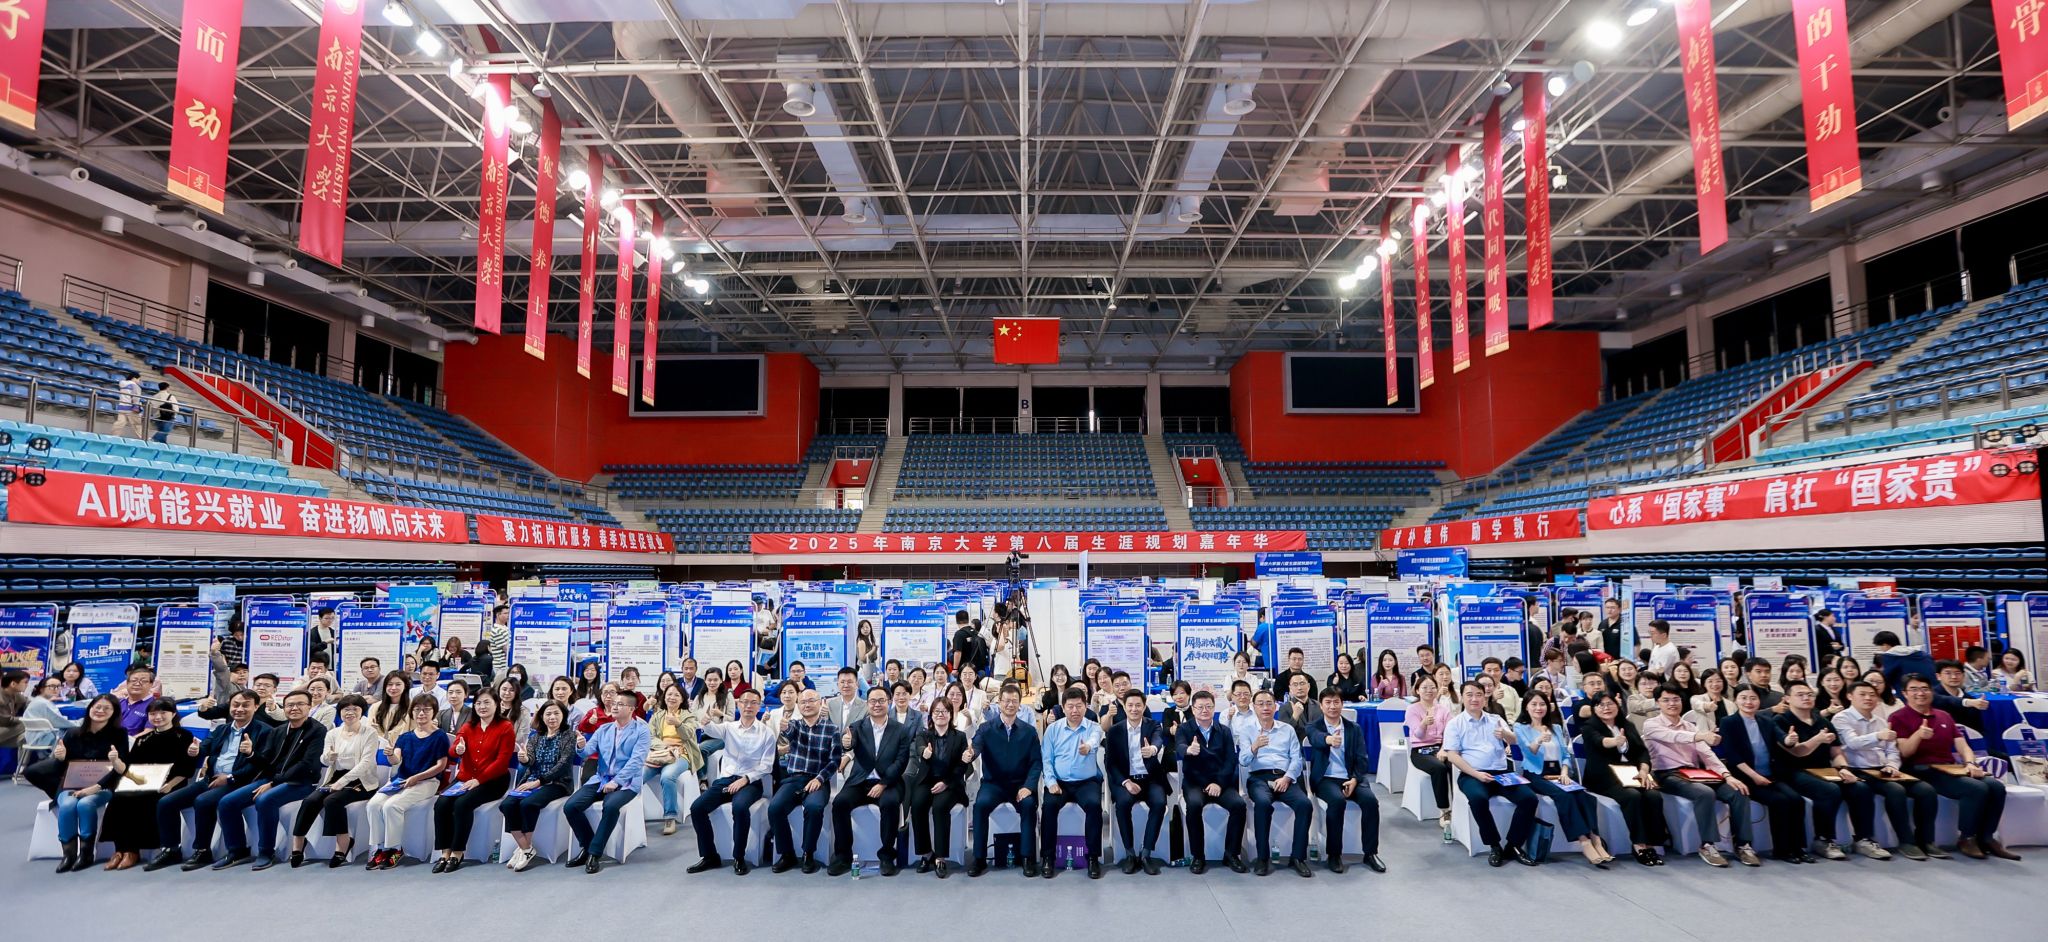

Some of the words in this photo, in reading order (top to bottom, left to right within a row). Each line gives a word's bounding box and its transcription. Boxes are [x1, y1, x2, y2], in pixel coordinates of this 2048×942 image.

[340, 46, 355, 115] NANJING
[1699, 24, 1710, 92] NANJING
[1705, 95, 1720, 185] UNIVERSITY
[1806, 7, 1842, 142] 的干劲
[332, 117, 351, 208] UNIVERSITY
[495, 161, 504, 216] NANJING
[492, 217, 503, 288] UNIVERSITY
[1486, 154, 1502, 315] 与时代同呼吸
[1021, 399, 1029, 409] B
[77, 482, 287, 530] AI赋能兴就业
[298, 501, 446, 539] 奋进扬帆向未来
[501, 519, 592, 547] 聚力拓岗优服务
[598, 529, 665, 550] 春季攻坚促就业
[1393, 525, 1449, 546] 诚朴雄伟
[1471, 513, 1550, 542] 励学敦行
